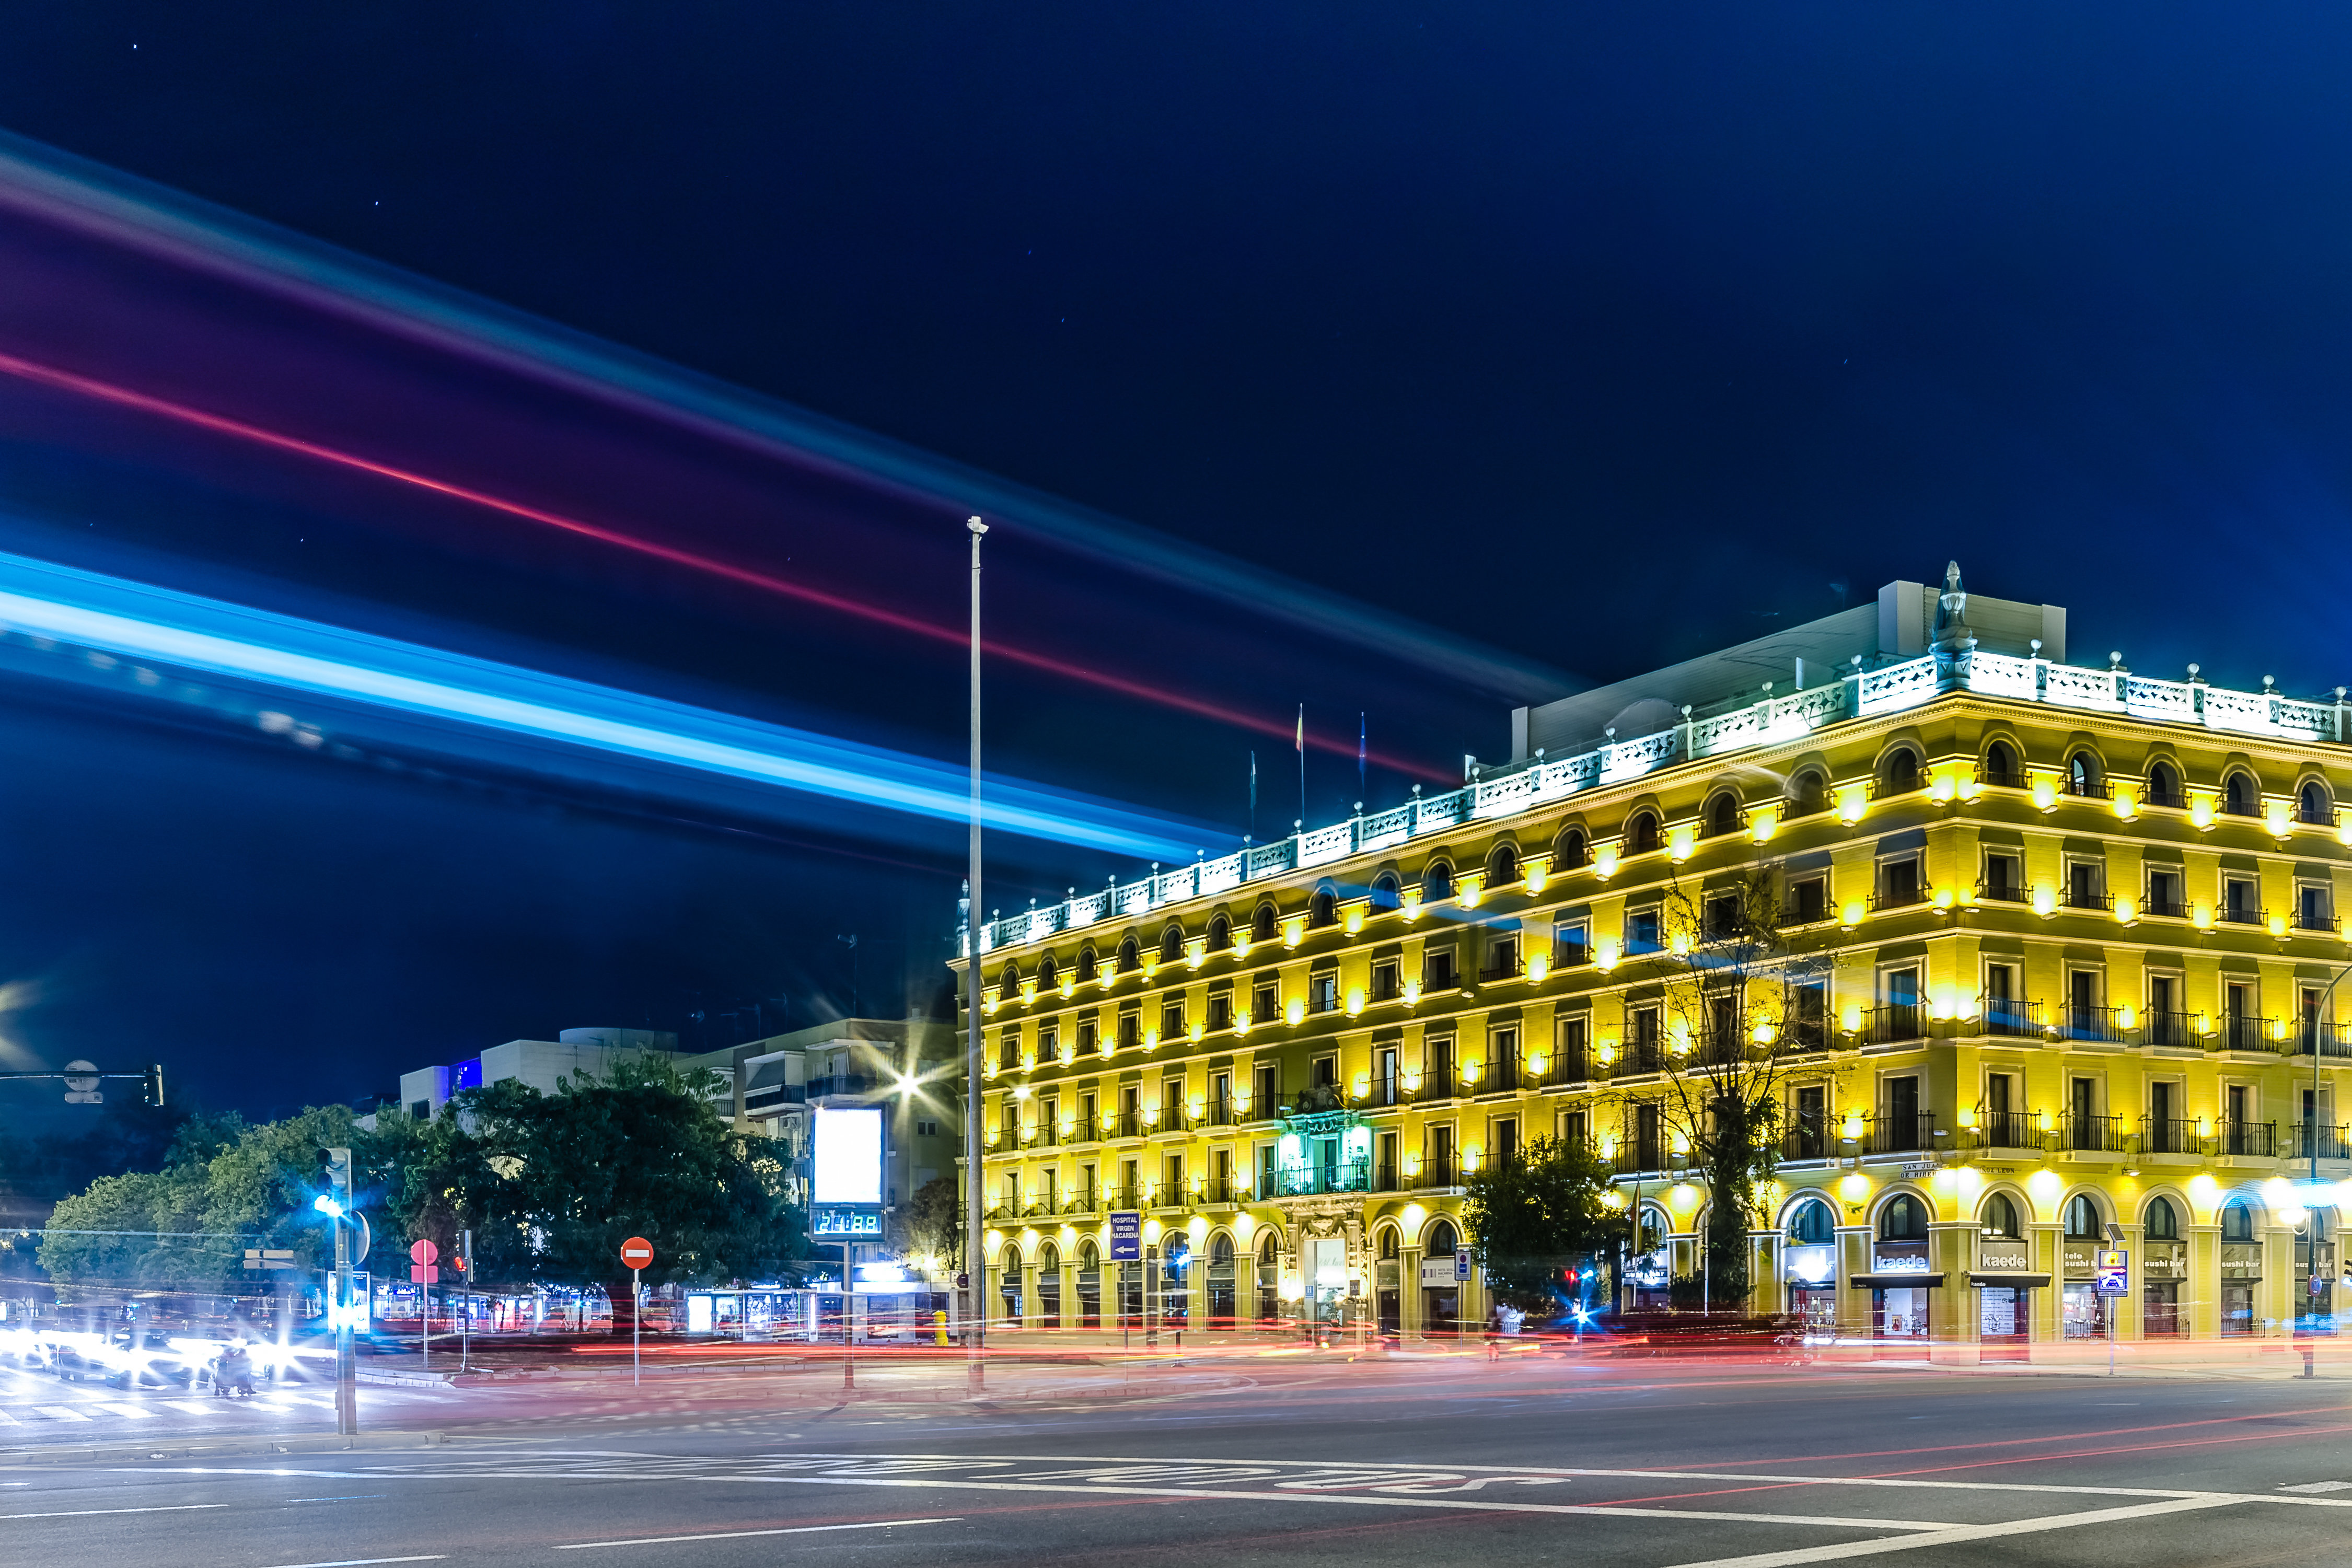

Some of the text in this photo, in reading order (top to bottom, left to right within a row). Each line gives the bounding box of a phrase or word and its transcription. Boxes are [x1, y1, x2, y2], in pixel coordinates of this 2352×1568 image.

[1876, 1254, 1926, 1269] kaede
[1982, 1254, 2026, 1268] kaede
[967, 1465, 1571, 1494] MOTOS
